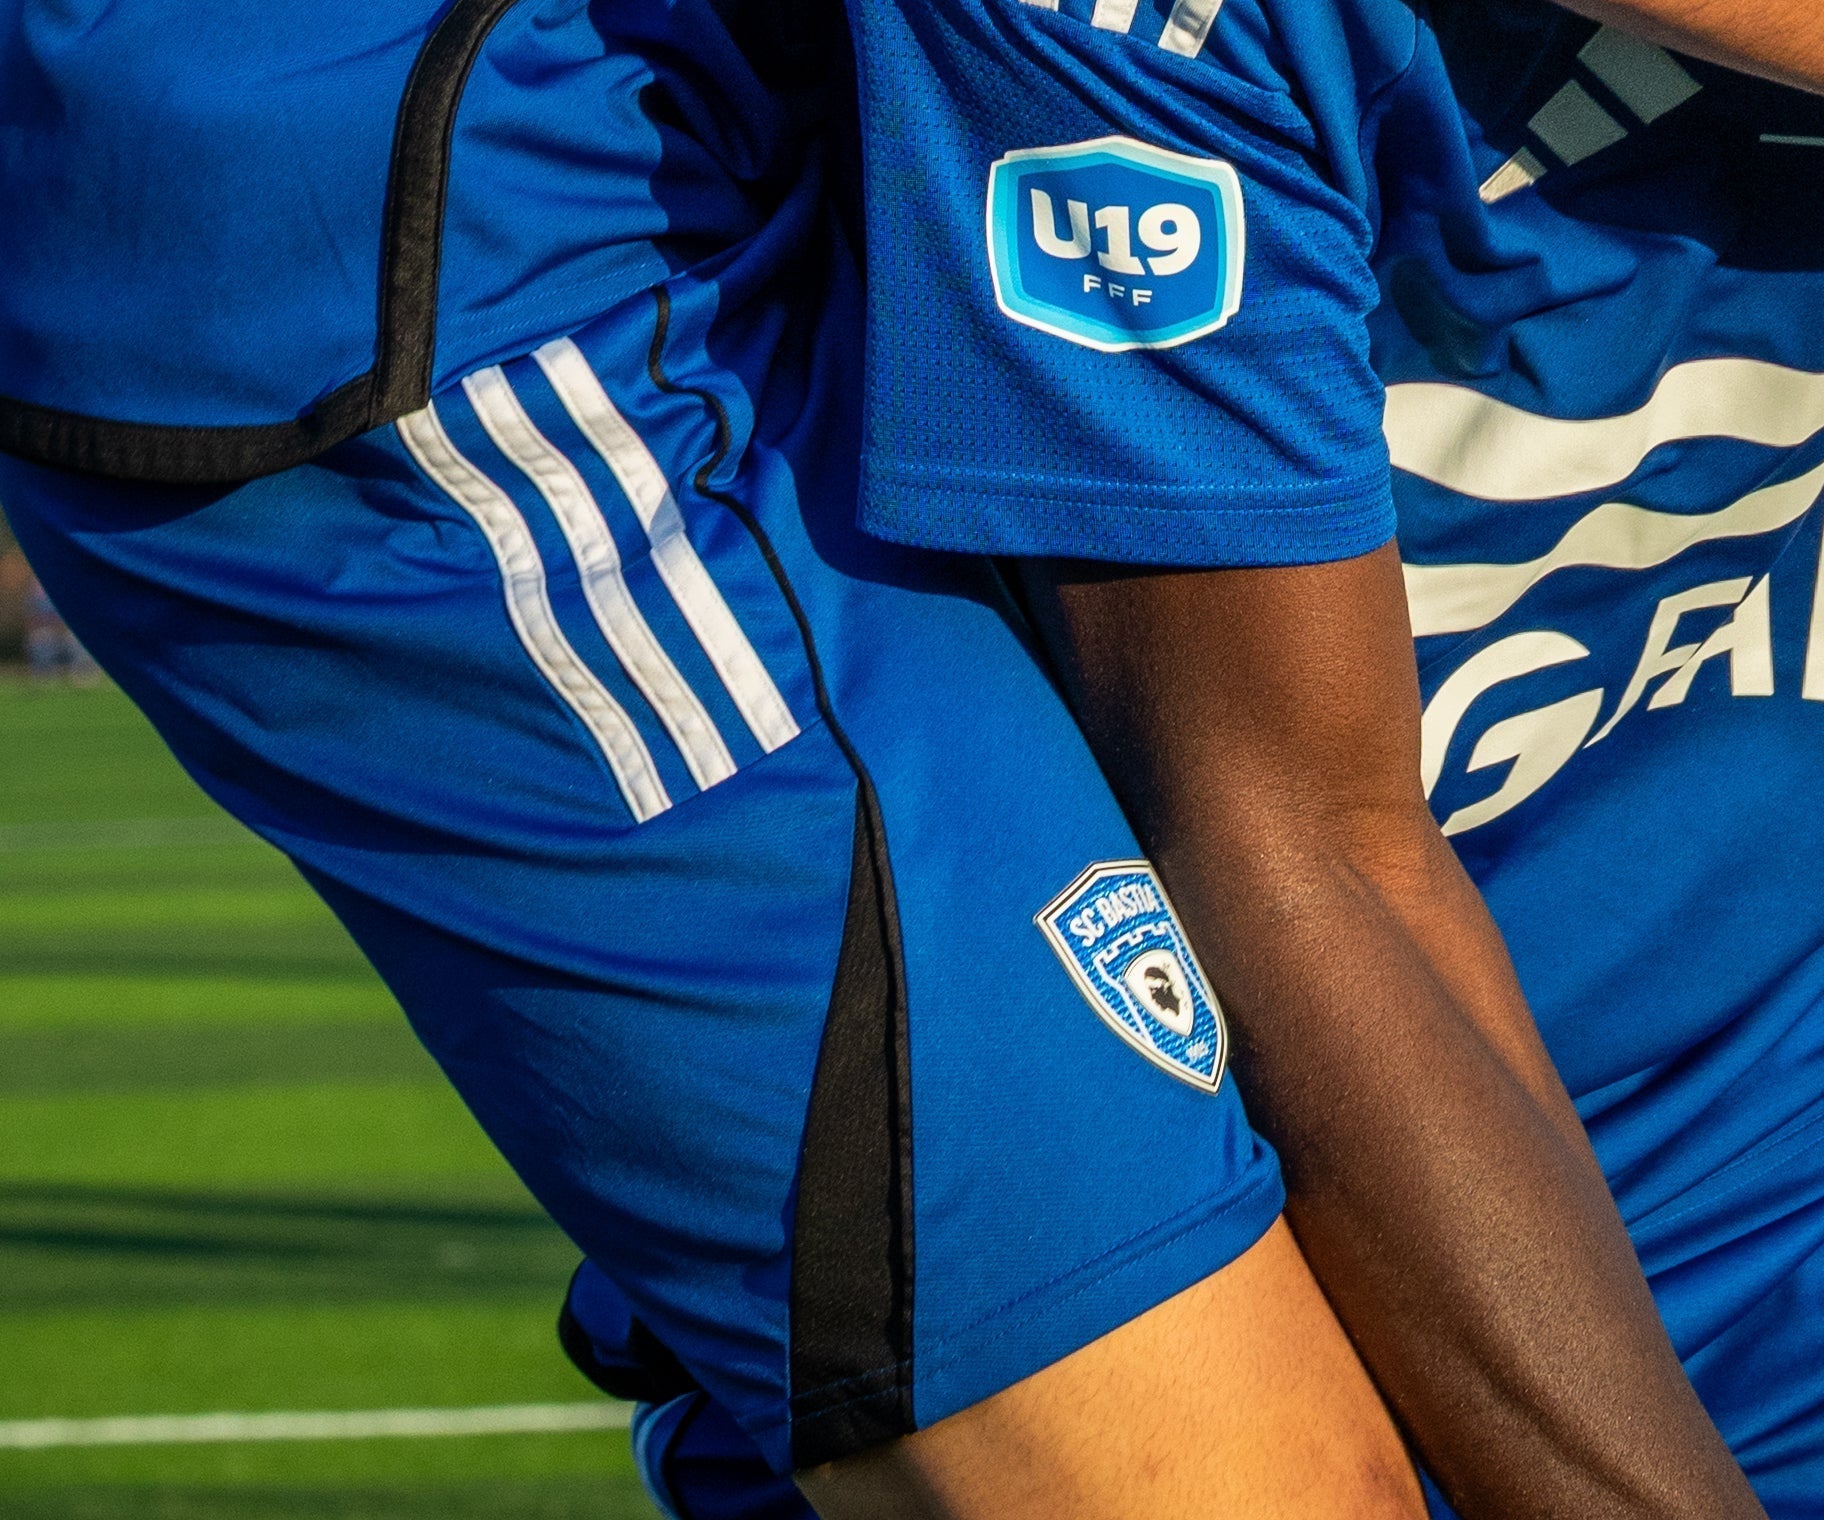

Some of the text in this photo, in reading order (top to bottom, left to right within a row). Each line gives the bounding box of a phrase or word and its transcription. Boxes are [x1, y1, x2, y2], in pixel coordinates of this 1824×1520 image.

[1030, 188, 1201, 276] U19
[1083, 274, 1153, 306] FFF
[1069, 883, 1161, 947] SC BASTIA
